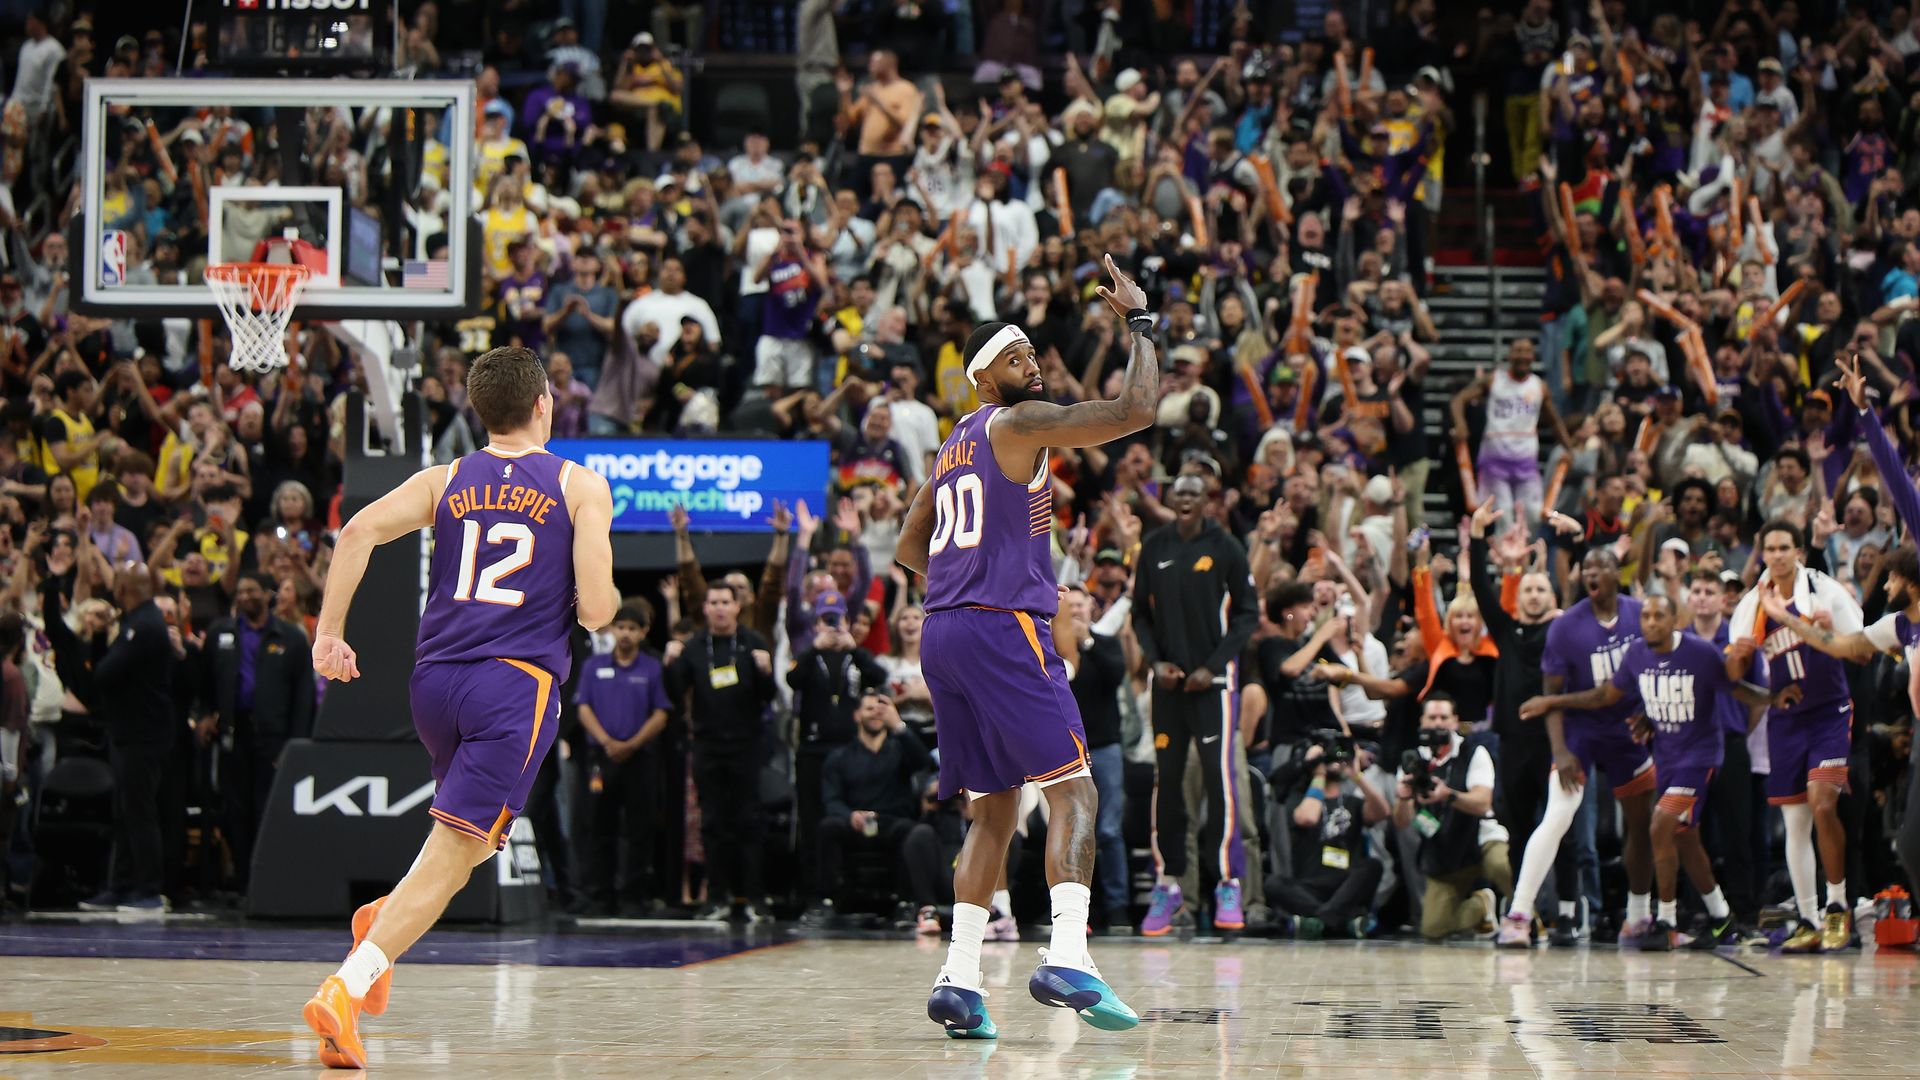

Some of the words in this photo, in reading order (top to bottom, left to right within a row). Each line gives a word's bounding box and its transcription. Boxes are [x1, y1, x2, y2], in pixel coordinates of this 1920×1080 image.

[584, 449, 763, 490] mortgage
[447, 484, 558, 525] GILLESPIE
[635, 486, 763, 519] matchup
[928, 472, 984, 557] 00
[453, 519, 536, 607] 12
[1638, 673, 1695, 704] BLACK
